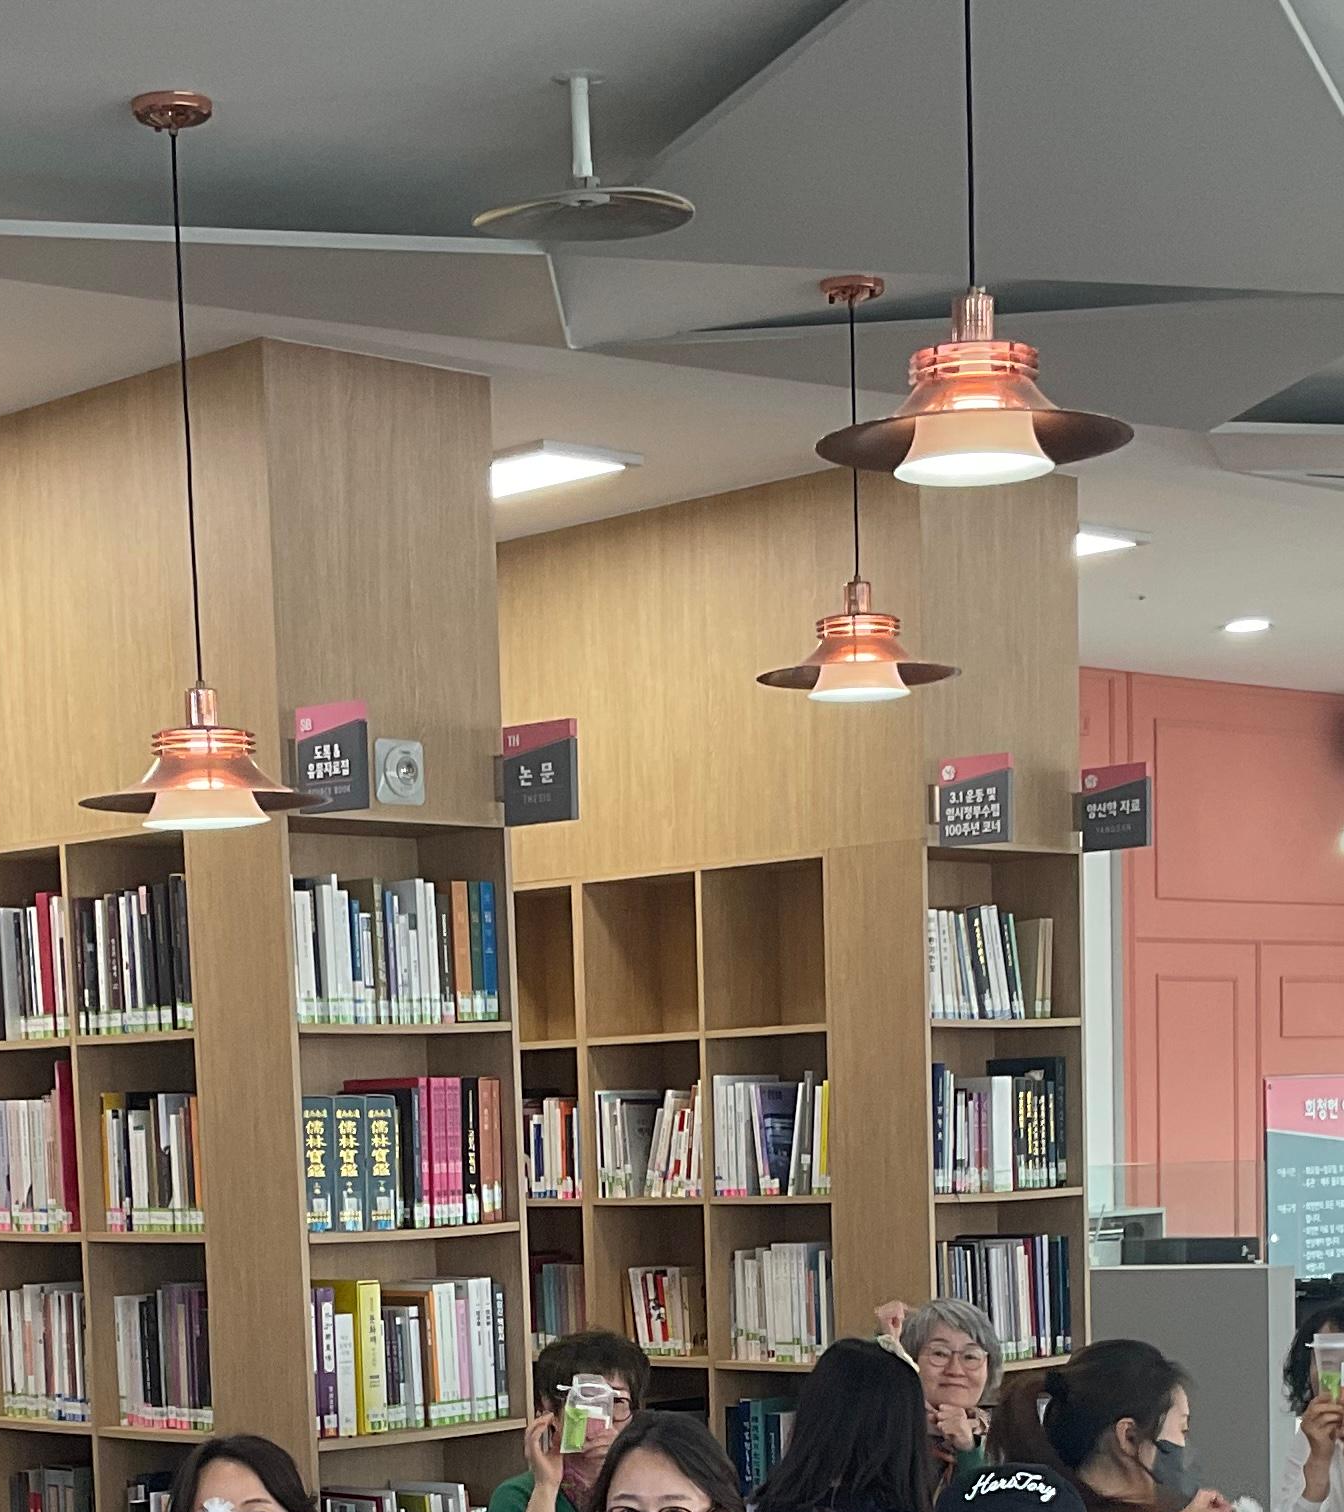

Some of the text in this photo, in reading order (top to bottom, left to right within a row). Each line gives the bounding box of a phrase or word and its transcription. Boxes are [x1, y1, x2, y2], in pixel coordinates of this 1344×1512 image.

[314, 744, 332, 761] 도록
[949, 786, 996, 804] 3.1 운동 및
[945, 803, 1001, 822] 임시정부수립
[945, 819, 1001, 837] 100주년 코너
